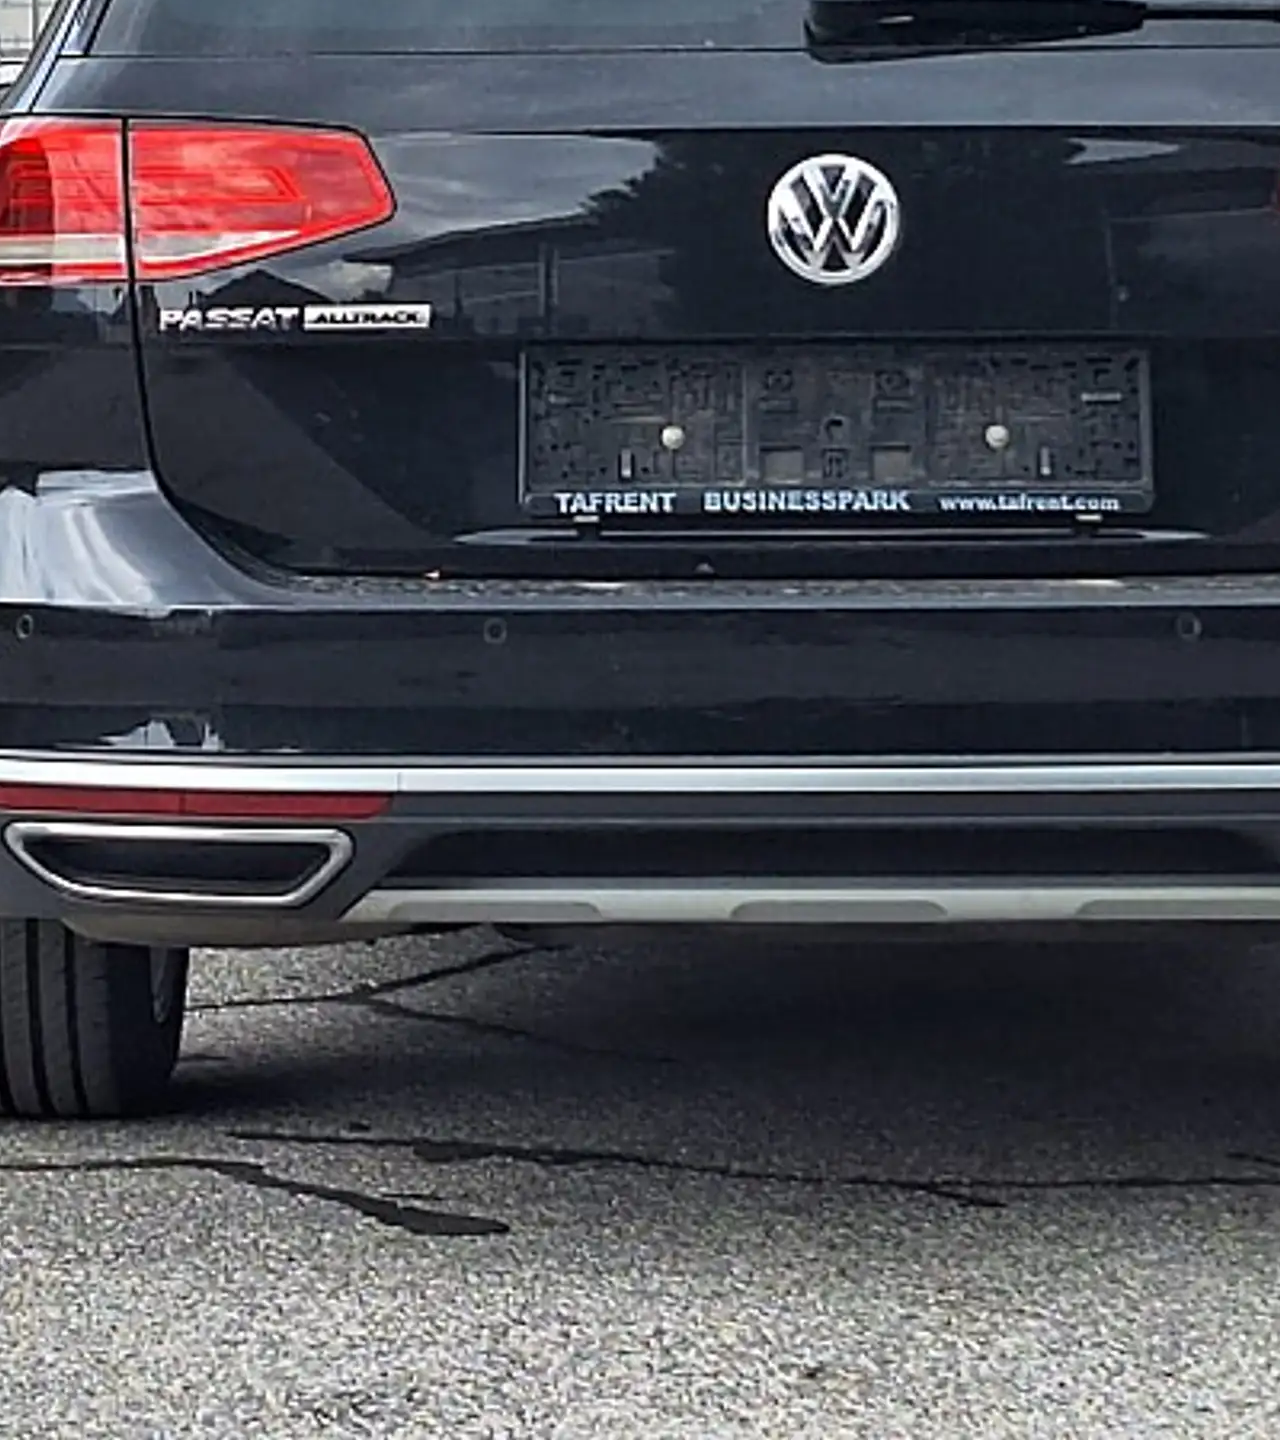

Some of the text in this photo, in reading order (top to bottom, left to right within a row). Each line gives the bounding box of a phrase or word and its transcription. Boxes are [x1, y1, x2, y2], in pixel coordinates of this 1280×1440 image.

[159, 305, 422, 331] PASSAT ALLTRACK
[554, 490, 1120, 513] TAFRENT BUSINESSPARK www.tafrent.com
